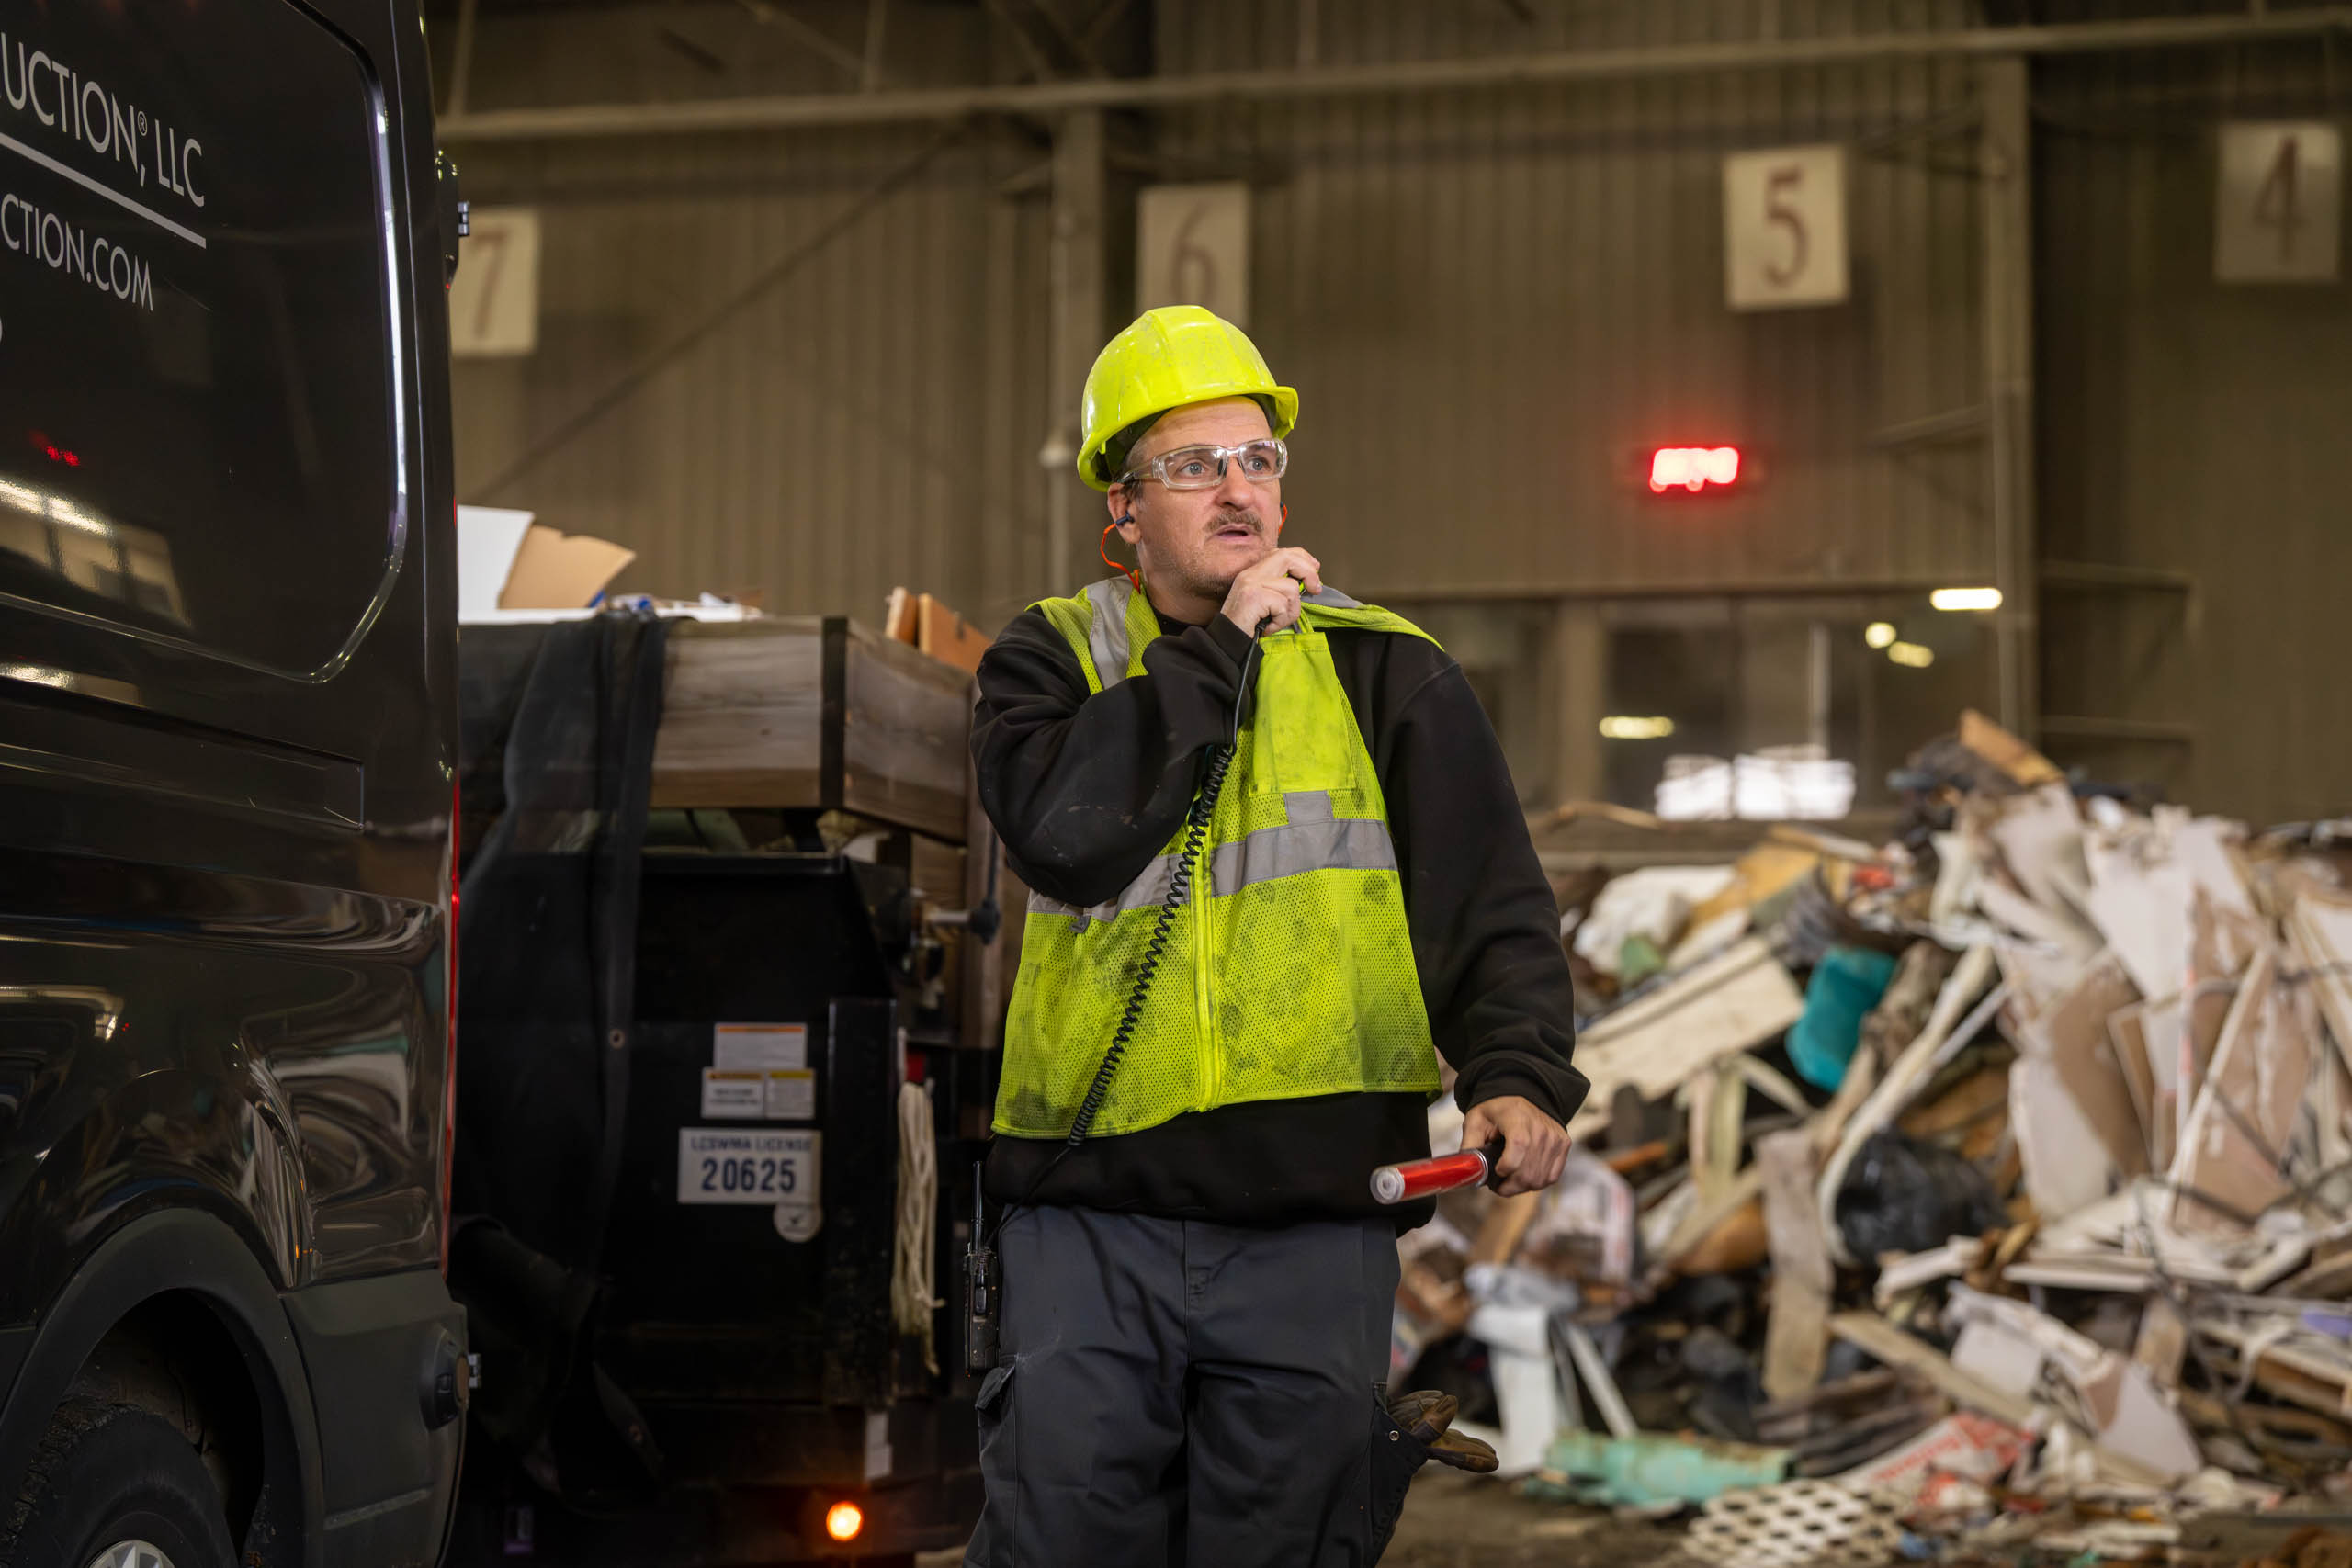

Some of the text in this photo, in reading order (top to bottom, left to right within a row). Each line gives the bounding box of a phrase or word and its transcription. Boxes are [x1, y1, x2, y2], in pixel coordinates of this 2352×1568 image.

[154, 119, 205, 208] LLC
[2250, 136, 2313, 265] 4
[1, 193, 153, 312] CTION.COM
[467, 227, 514, 340] 7
[1170, 200, 1218, 304] 6
[1764, 167, 1810, 292] 5
[700, 1157, 797, 1191] 20625
